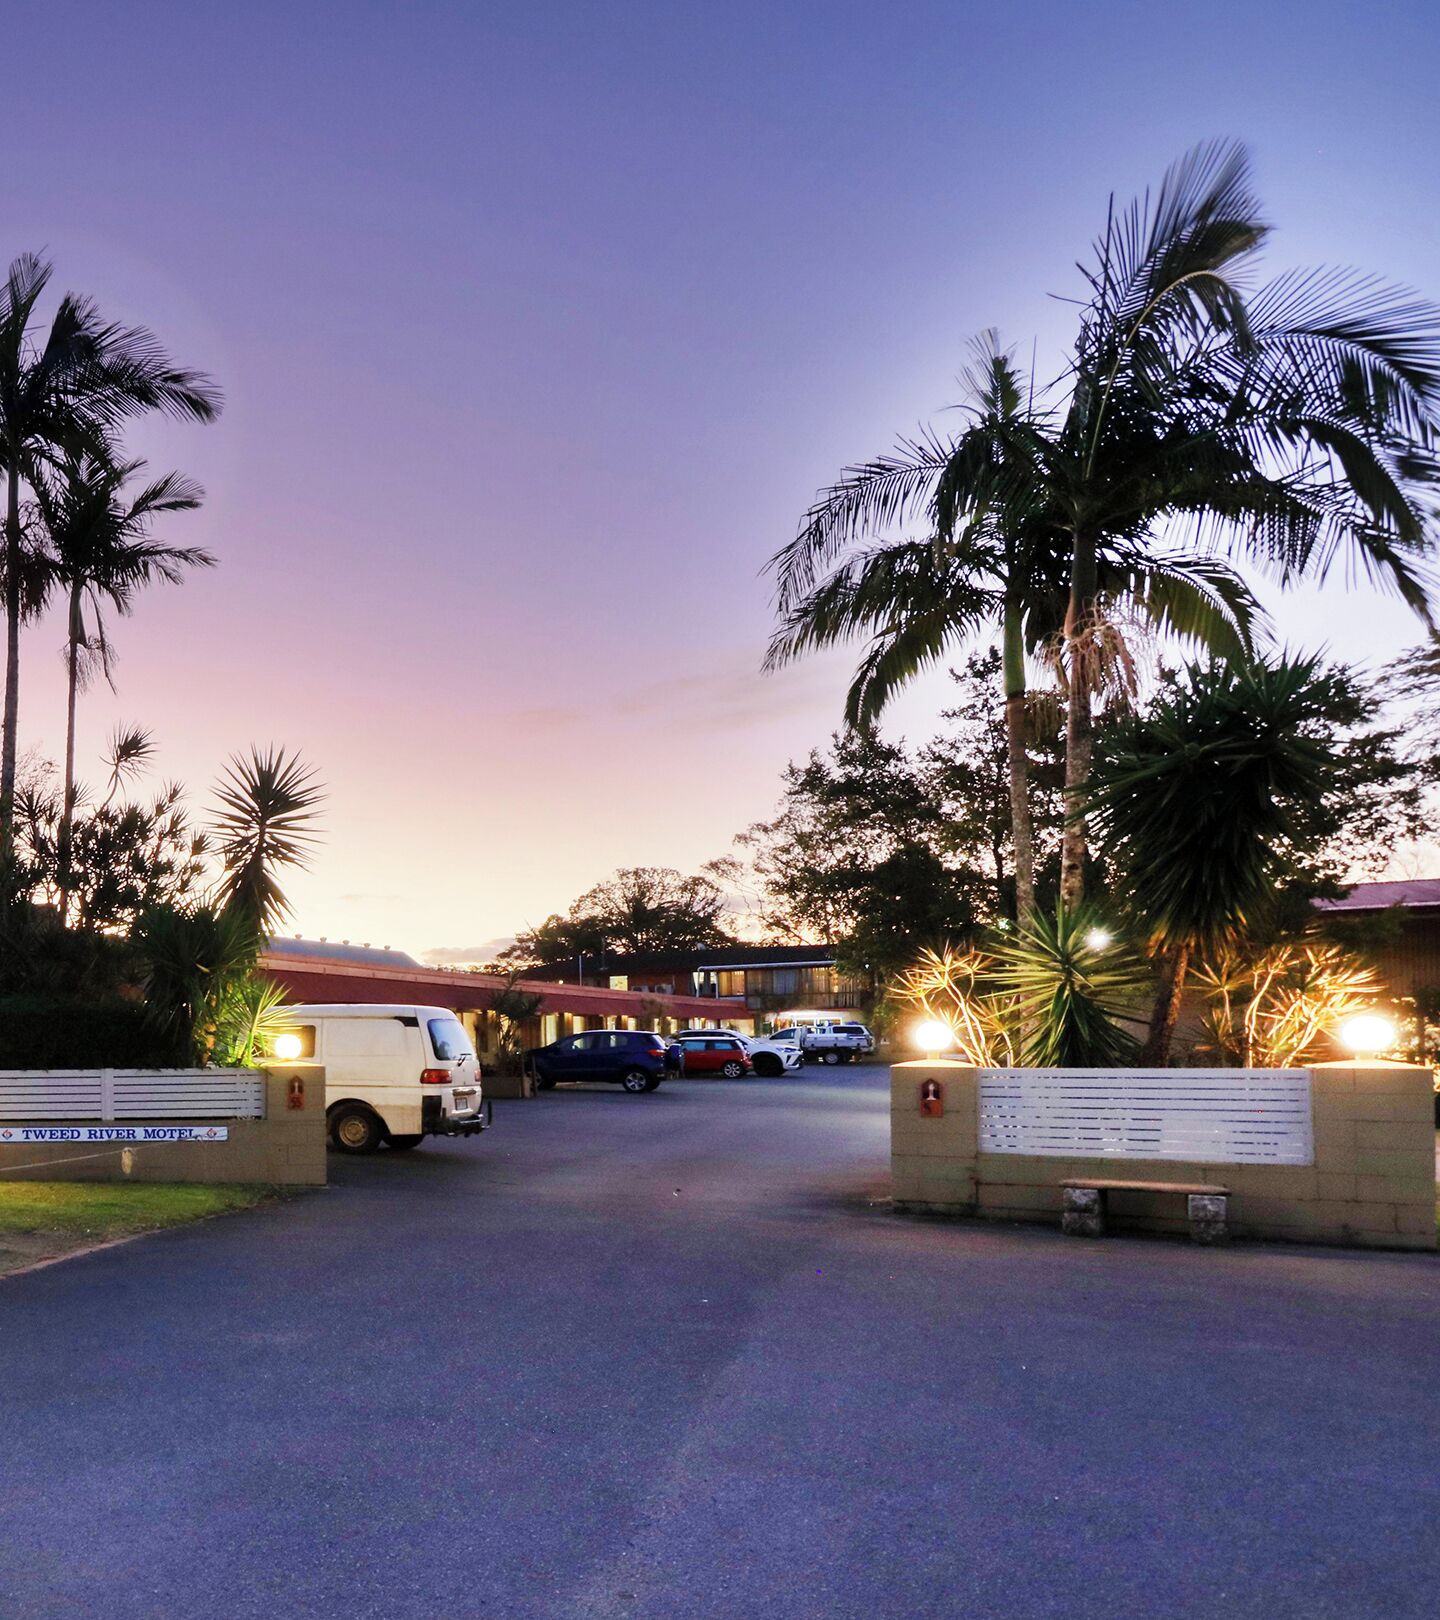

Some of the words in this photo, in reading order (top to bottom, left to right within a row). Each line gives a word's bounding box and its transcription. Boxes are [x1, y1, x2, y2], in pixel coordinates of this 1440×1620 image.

[22, 1128, 81, 1140] TWEED
[87, 1128, 137, 1139] RIVER
[143, 1128, 195, 1139] MOTEL
